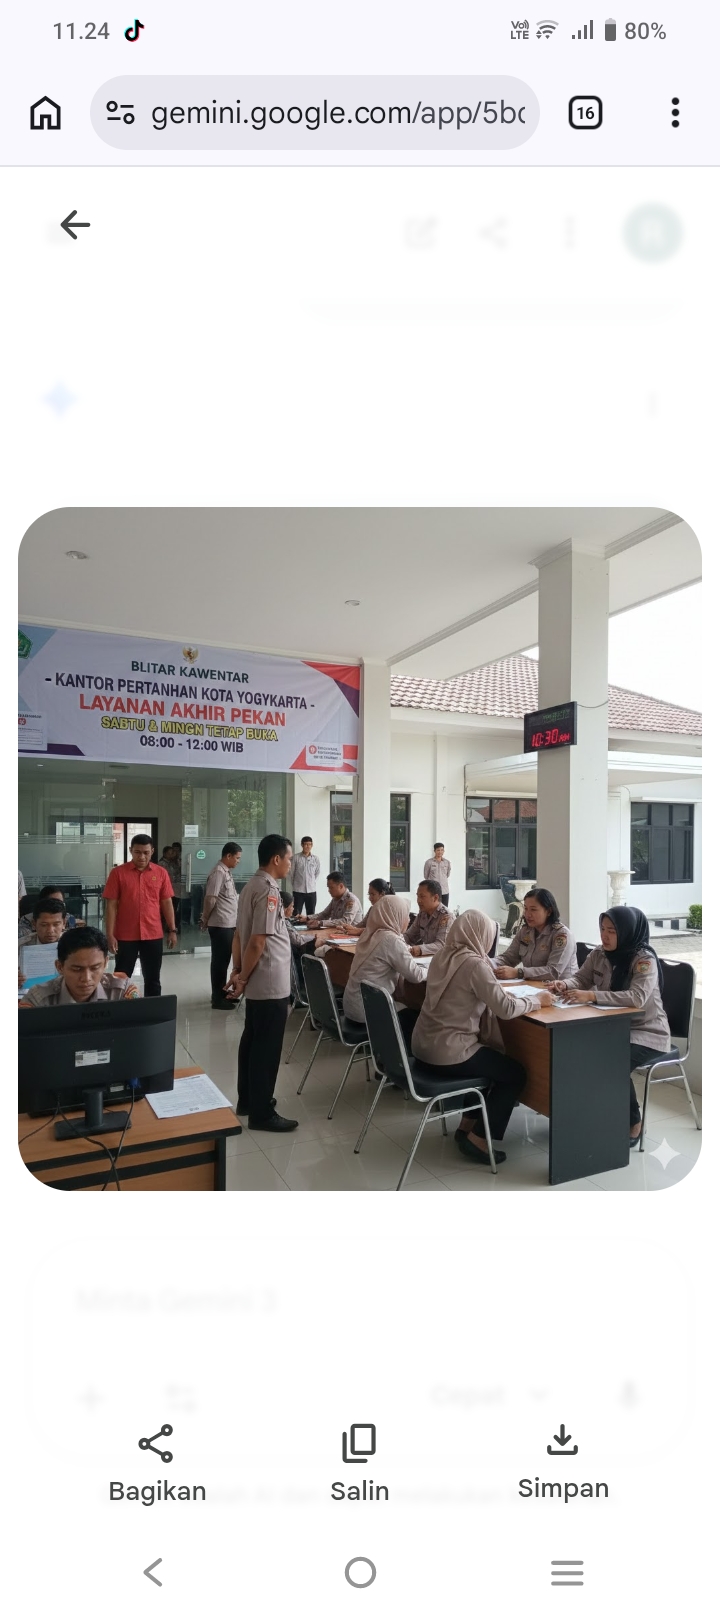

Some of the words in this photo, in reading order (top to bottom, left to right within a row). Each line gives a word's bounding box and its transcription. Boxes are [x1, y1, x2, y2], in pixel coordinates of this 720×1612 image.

[53, 22, 110, 40] 11.24
[511, 30, 529, 40] LTE
[624, 22, 667, 40] 80%
[577, 106, 595, 120] 16
[131, 661, 176, 676] BLITAR
[179, 666, 250, 684] KAWENTAR
[55, 672, 114, 692] KANTOR
[117, 679, 198, 700] PERTANHAN
[201, 687, 234, 703] KOTA
[236, 690, 308, 709] YOGYKARTA
[79, 693, 165, 716] LAYANAN
[170, 702, 226, 722] AKHIR
[230, 707, 286, 727] PEKAN
[101, 715, 145, 731] SABTU
[148, 720, 158, 732] &
[160, 720, 204, 736] MINGN
[206, 725, 244, 739] TETAP
[246, 728, 279, 742] BUKA
[531, 728, 559, 747] 10:30
[139, 735, 175, 748] 08:00
[186, 739, 218, 751] 12:00
[220, 741, 244, 753] WIB
[108, 1480, 207, 1507] Bagikan
[330, 1479, 390, 1502] Salin
[517, 1476, 609, 1504] Simpan
